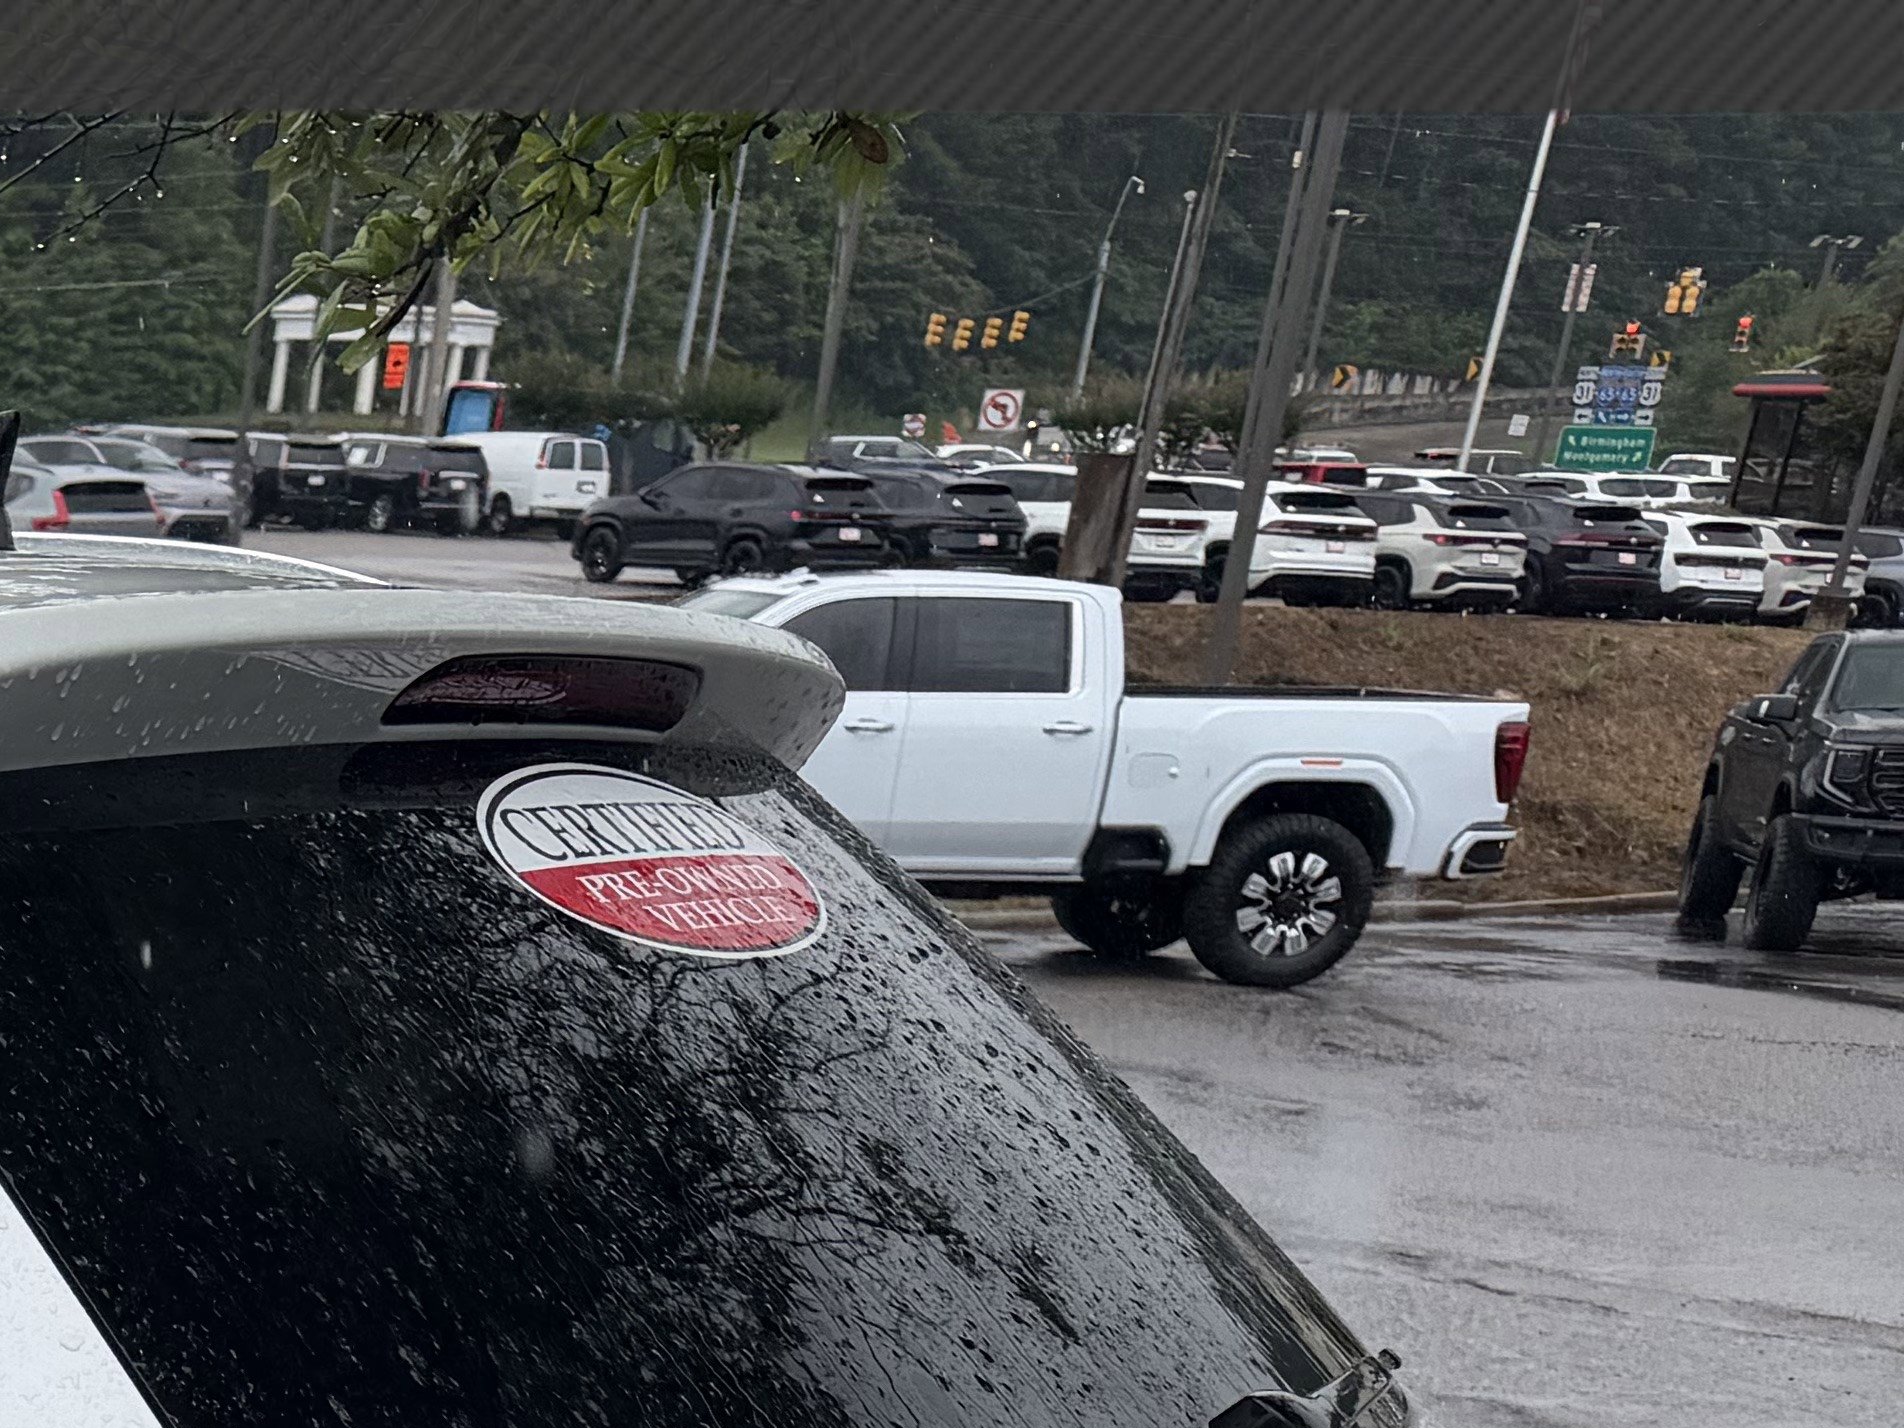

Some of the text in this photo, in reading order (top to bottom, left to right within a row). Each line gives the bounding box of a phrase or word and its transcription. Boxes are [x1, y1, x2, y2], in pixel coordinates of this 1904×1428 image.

[1580, 435, 1646, 451] Birmingham
[499, 801, 746, 862] CERTIFIED
[575, 863, 783, 904] PRE-OWNED
[643, 897, 796, 932] VEHICLE
